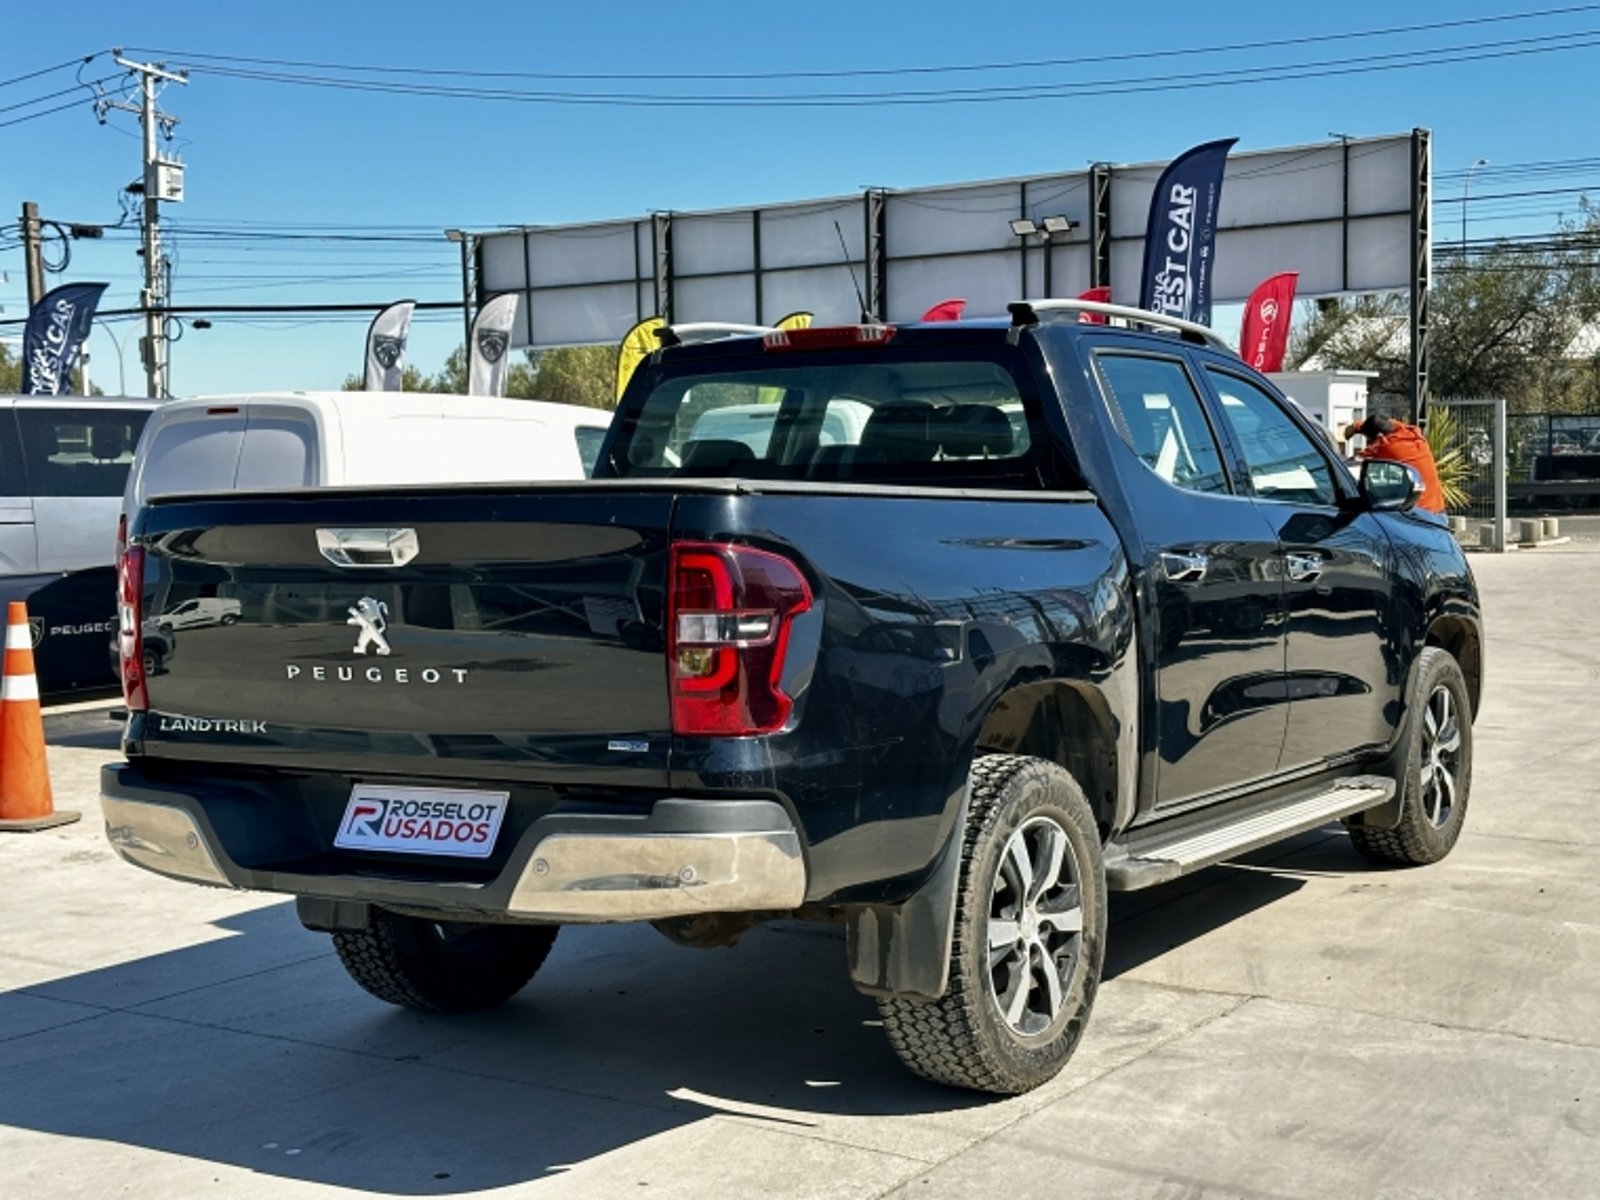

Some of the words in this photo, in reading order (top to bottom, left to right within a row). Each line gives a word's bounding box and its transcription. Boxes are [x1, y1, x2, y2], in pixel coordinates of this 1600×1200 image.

[1166, 183, 1194, 253] CAR
[1152, 271, 1167, 312] ONA
[1161, 256, 1186, 313] EST
[46, 299, 75, 344] CAR
[50, 622, 112, 636] PEUGEO
[286, 665, 468, 684] PEUGEOT
[160, 717, 267, 734] LANDTREK
[389, 799, 498, 822] ROSSELOT
[384, 818, 490, 843] USADOS
